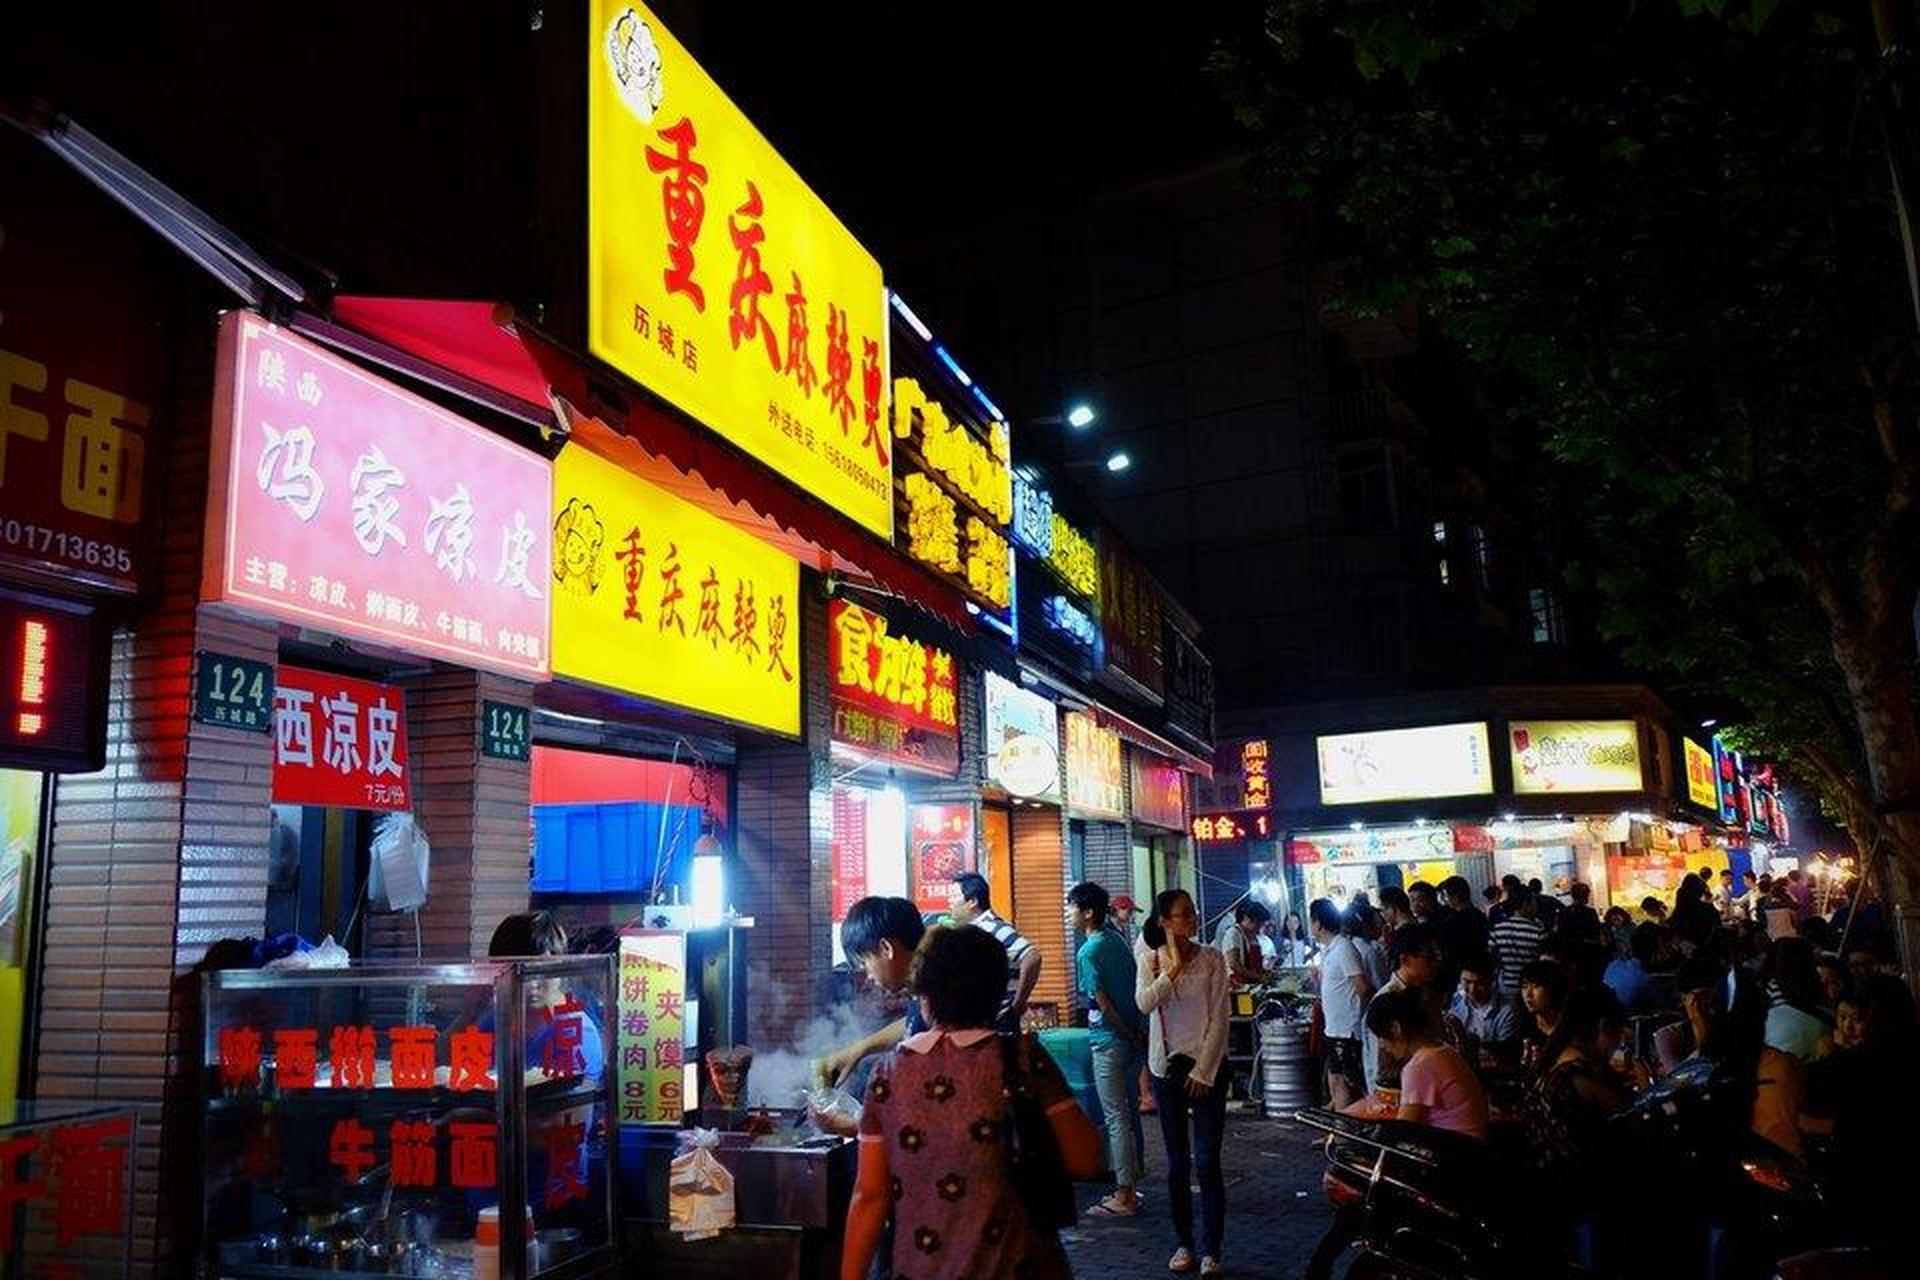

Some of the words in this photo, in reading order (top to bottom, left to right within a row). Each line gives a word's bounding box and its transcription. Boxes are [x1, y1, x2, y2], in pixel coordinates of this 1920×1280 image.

[645, 117, 889, 468] 重庆麻辣烫
[633, 303, 699, 374] 历城店
[258, 350, 323, 407] 陕西
[256, 424, 544, 599] 冯家凉皮
[614, 525, 793, 682] 重庆麻辣烫
[209, 663, 264, 708] 124
[274, 686, 405, 779] 西凉皮
[490, 708, 525, 741] 124
[217, 1023, 498, 1093] 陕西擀面皮
[328, 1116, 499, 1187] 牛筋面
